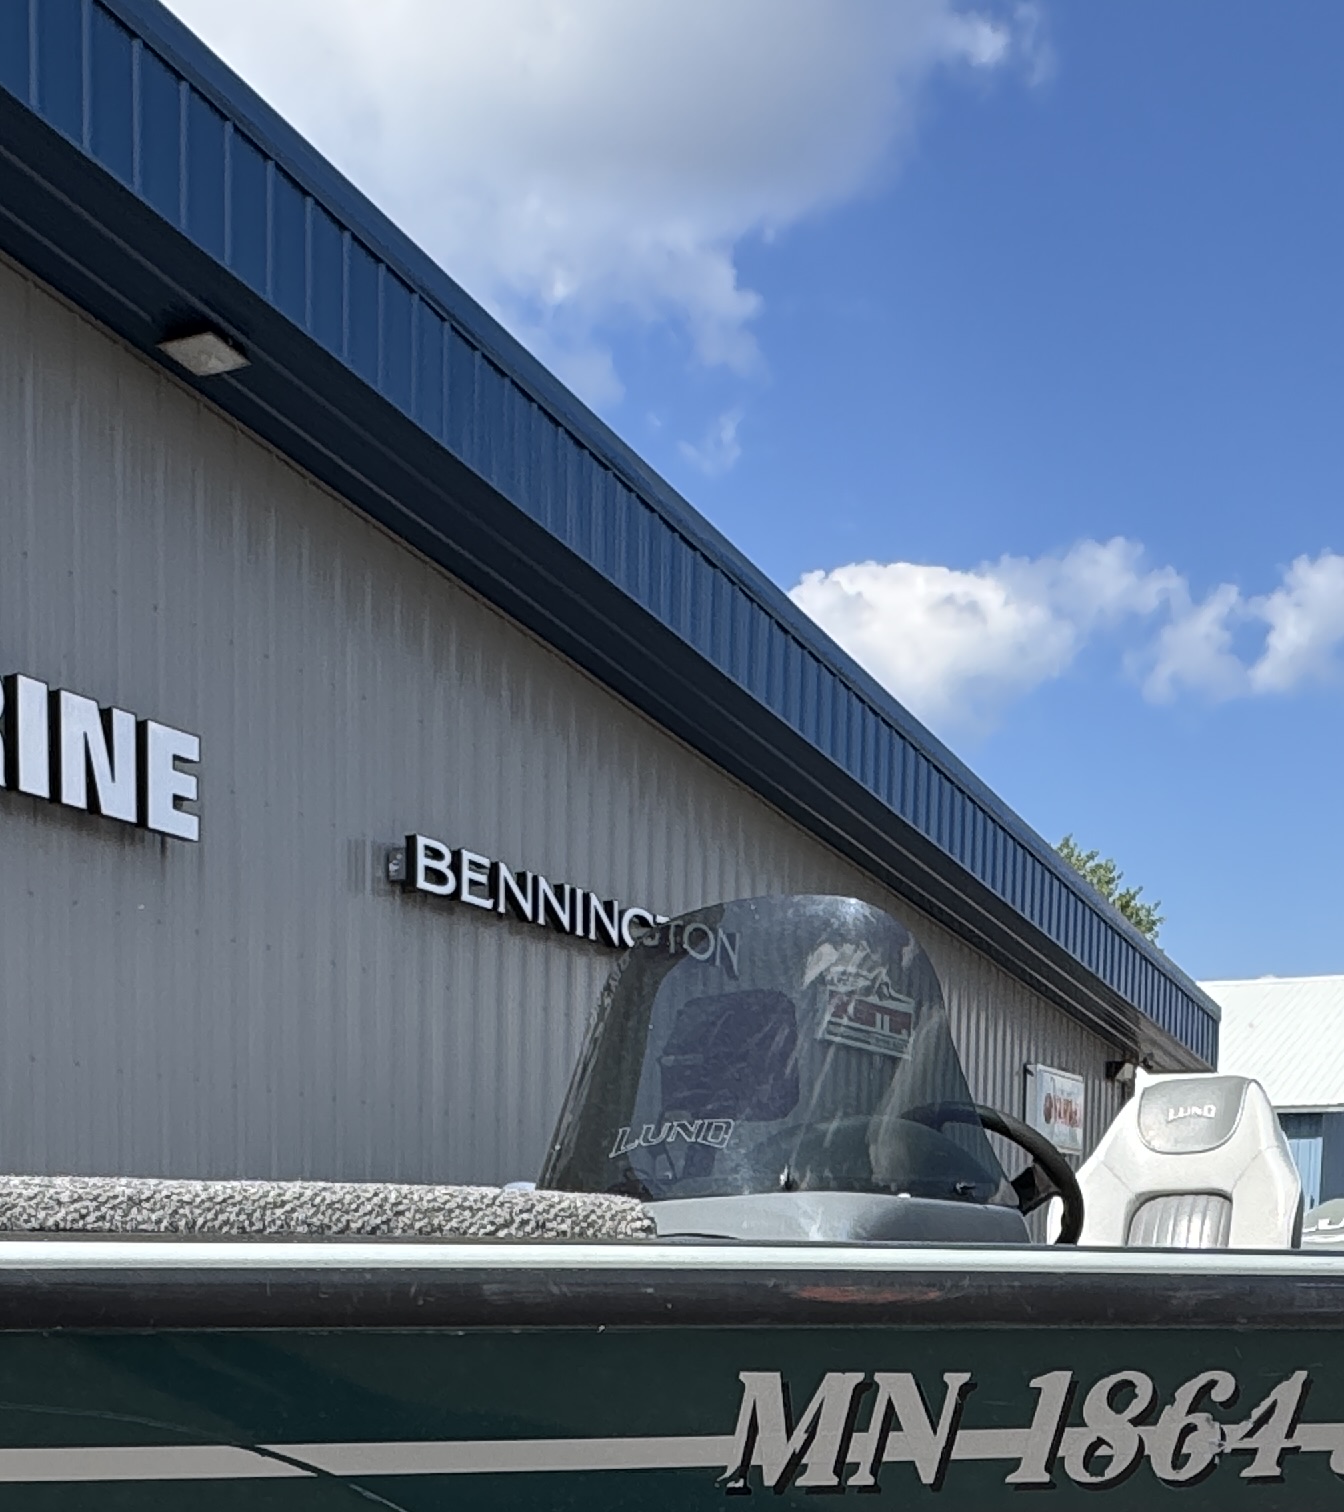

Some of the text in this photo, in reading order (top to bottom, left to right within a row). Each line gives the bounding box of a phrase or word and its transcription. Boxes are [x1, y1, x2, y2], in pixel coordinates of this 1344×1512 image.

[406, 834, 740, 977] BENNINGTON
[608, 1118, 736, 1158] LUND
[1168, 1104, 1217, 1122] LUND
[716, 1371, 976, 1495] MN
[1004, 1370, 1314, 1490] 1864
